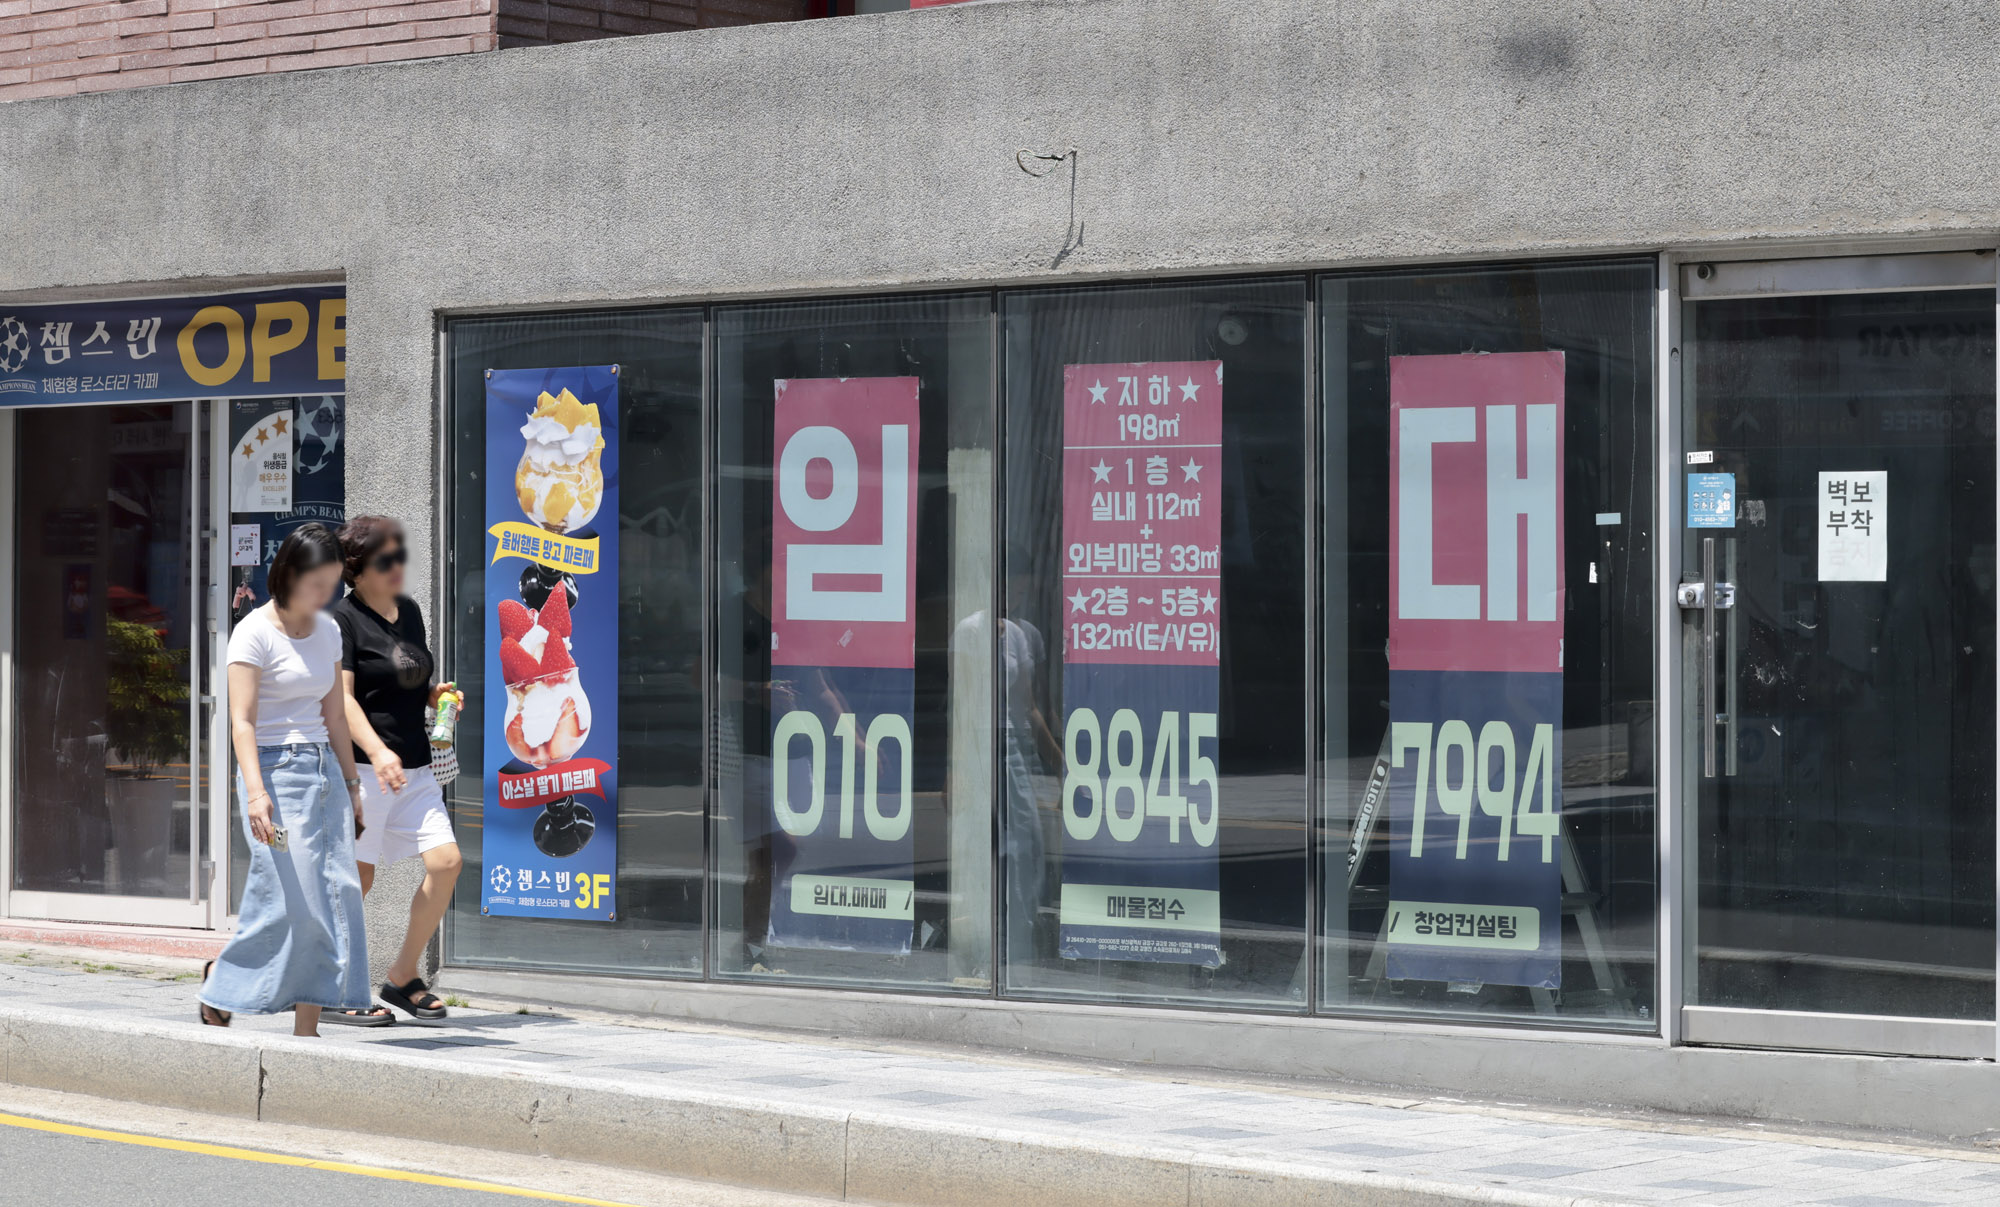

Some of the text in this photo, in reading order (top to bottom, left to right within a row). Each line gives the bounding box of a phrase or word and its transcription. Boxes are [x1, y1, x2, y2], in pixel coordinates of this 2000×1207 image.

[42, 372, 159, 394] 체험형 로스터리 카페
[264, 461, 288, 470] 위생등급
[1091, 491, 1136, 521] 실내
[1827, 479, 1874, 506] 벽보
[779, 423, 908, 622] 임
[1398, 403, 1557, 622] 대
[1826, 509, 1874, 536] 부착
[501, 530, 595, 569] 울버햄튼 망고 파르페
[1068, 543, 1162, 573] 외부마당
[1091, 585, 1129, 616] 2층
[1162, 585, 1199, 617] 5층
[502, 768, 596, 800] 아스날 딸기 파르페
[773, 710, 912, 841] 010
[1062, 707, 1219, 847] 8845
[1391, 719, 1560, 864] 7994
[518, 897, 535, 907] 체험형
[536, 897, 558, 907] 로스터리
[559, 899, 571, 908] 카페
[574, 872, 611, 909] 3F
[813, 884, 887, 910] 임대.매매
[1107, 895, 1186, 921] 매물접수
[1415, 911, 1517, 939] 창업컨설팅
